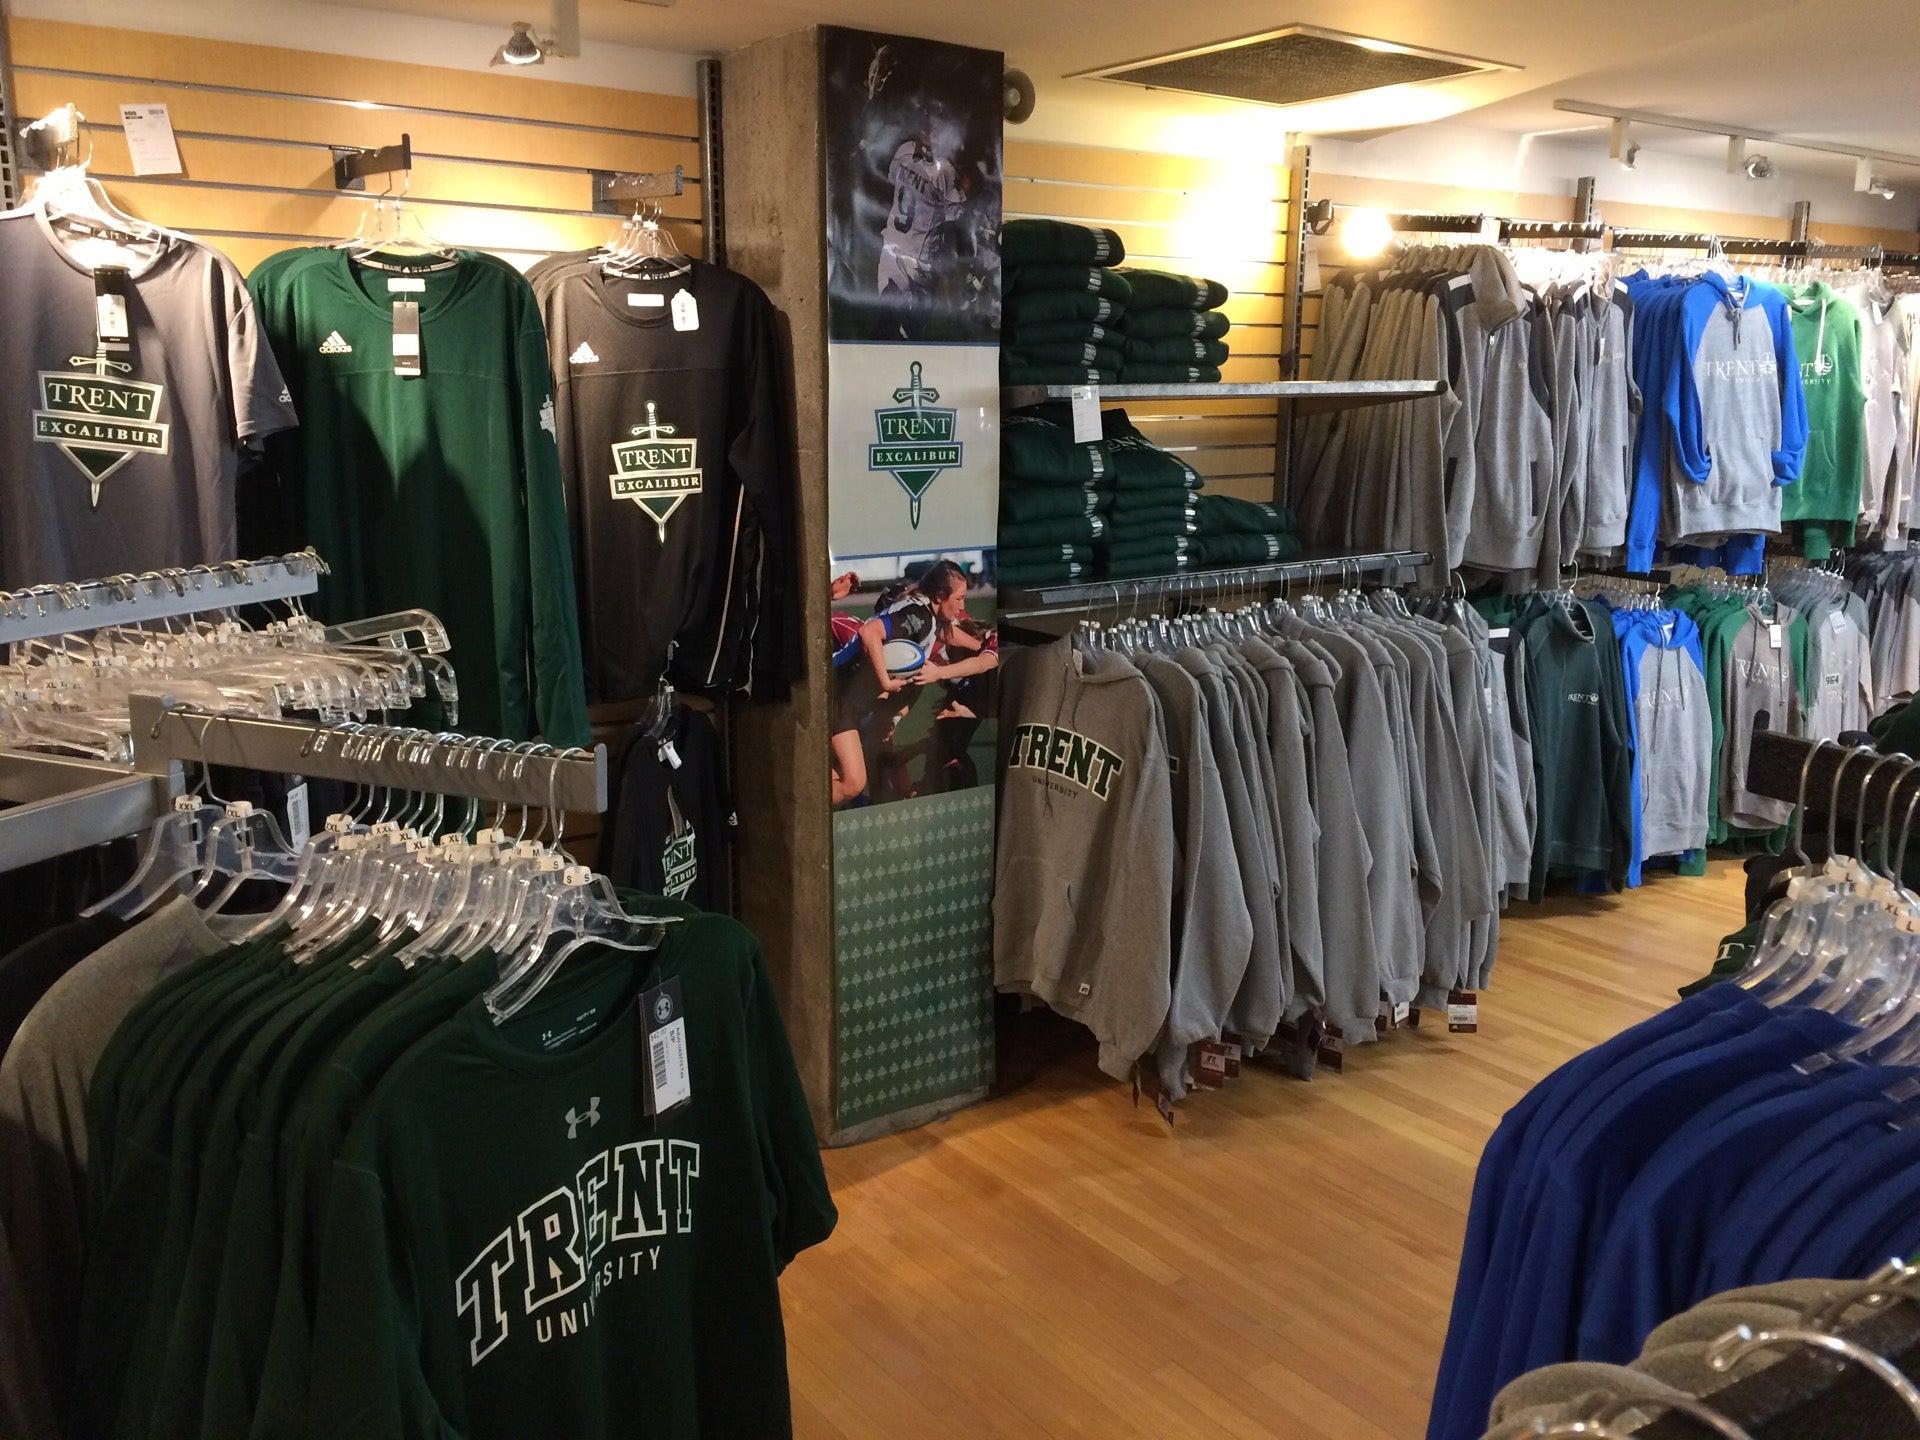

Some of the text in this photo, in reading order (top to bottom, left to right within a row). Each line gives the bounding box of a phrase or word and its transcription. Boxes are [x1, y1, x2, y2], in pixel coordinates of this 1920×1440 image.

[48, 383, 150, 413] TRENT
[39, 420, 159, 444] EXCALIBUR
[883, 418, 950, 440] TRENT
[620, 448, 690, 469] TRENT
[876, 450, 956, 462] EXCALIBUR
[617, 477, 699, 491] EXCALIBUR
[1008, 722, 1125, 801] TRENT
[178, 803, 196, 811] XXL
[400, 832, 412, 841] XL
[449, 834, 460, 843] XL
[489, 835, 496, 843] L
[413, 841, 426, 850] XL
[553, 861, 559, 869] S
[566, 873, 590, 883] S S
[1884, 902, 1898, 916] XL
[1906, 921, 1914, 932] L
[455, 1139, 700, 1367] TRENT
